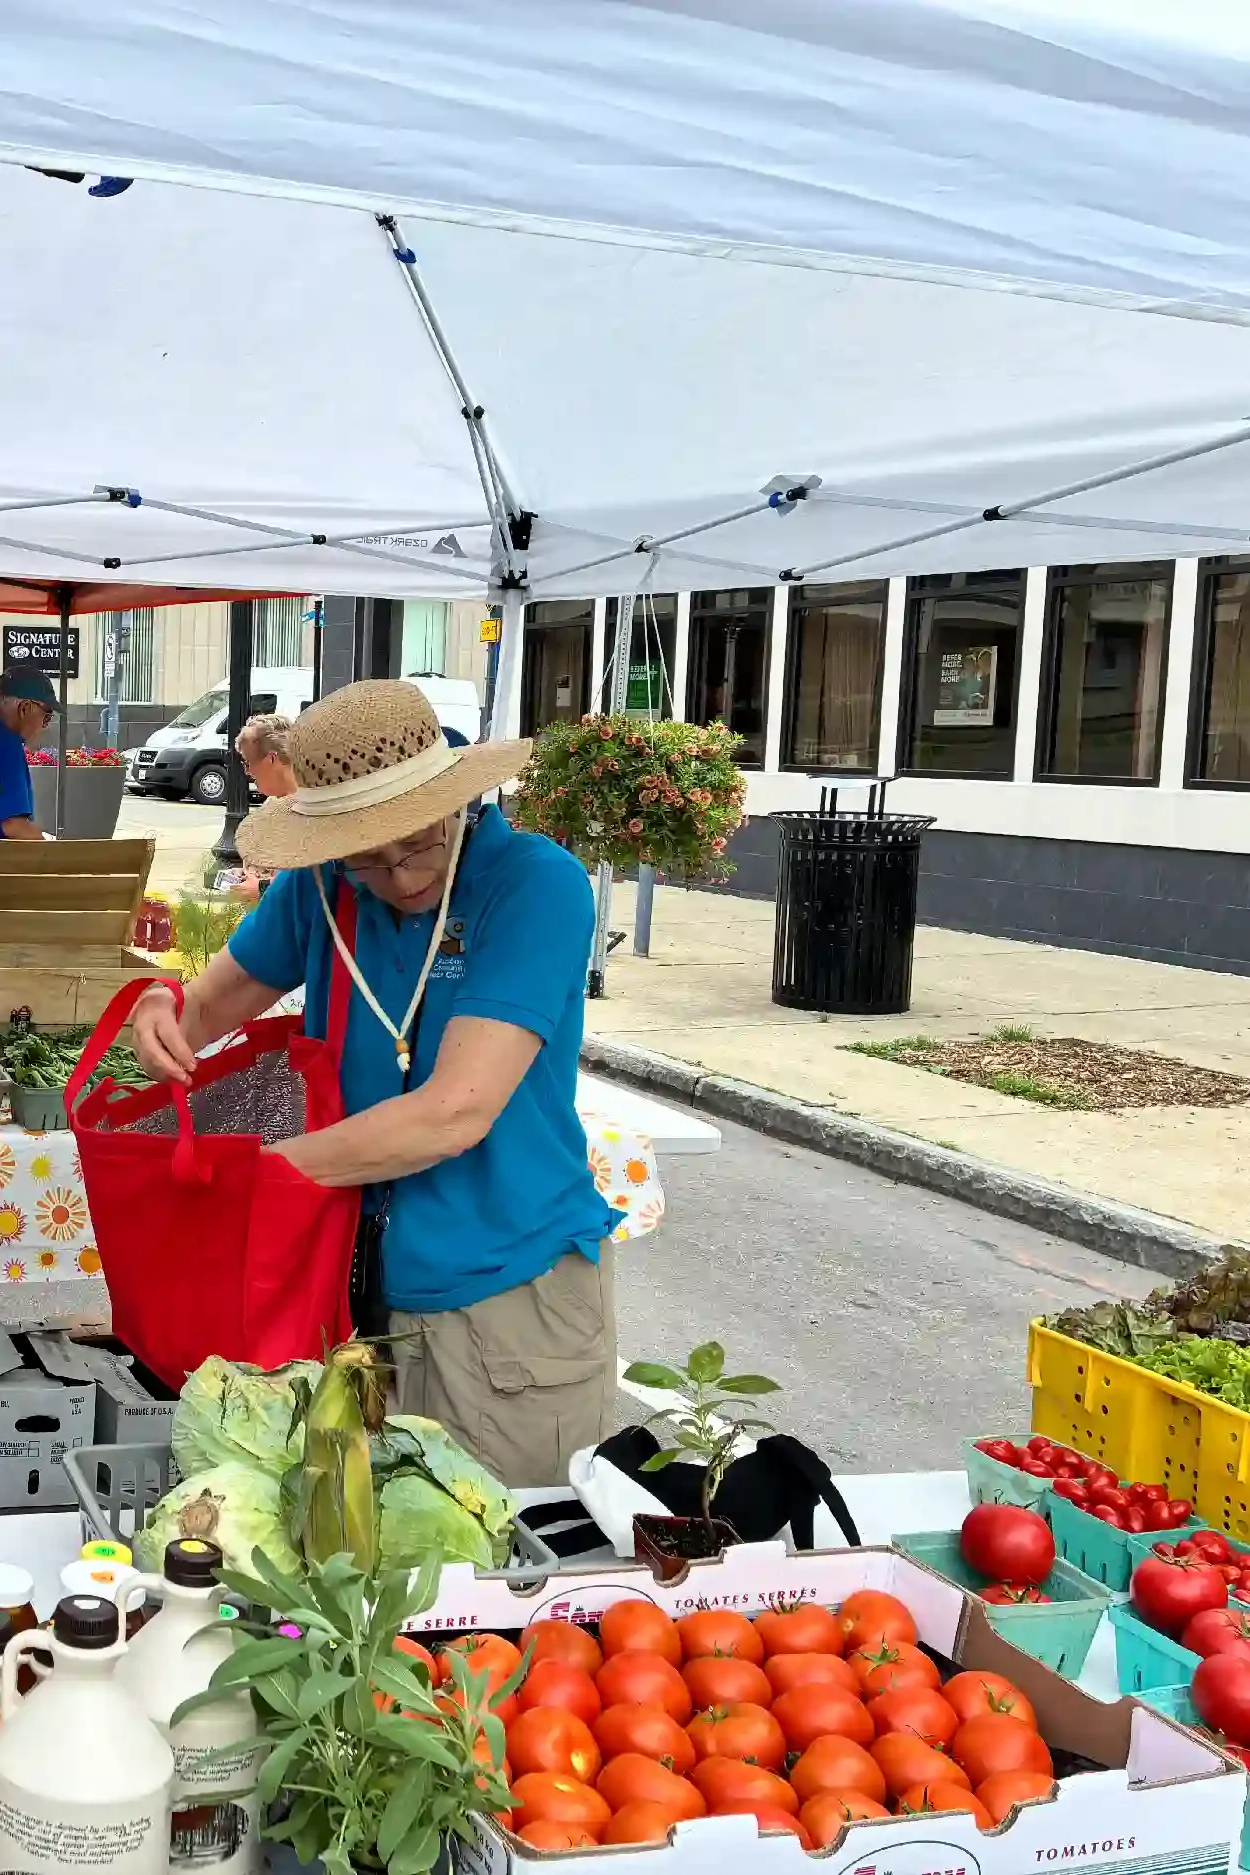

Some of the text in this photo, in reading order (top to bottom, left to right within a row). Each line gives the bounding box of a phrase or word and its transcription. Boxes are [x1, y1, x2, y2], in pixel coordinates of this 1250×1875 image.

[8, 630, 76, 645] SIGNATUE
[31, 645, 75, 659] CENTR
[124, 1408, 150, 1416] PRODUCE
[674, 1593, 749, 1609] TOMATES
[424, 1614, 479, 1629] SERRE
[1035, 1836, 1137, 1862] TOMATOES
